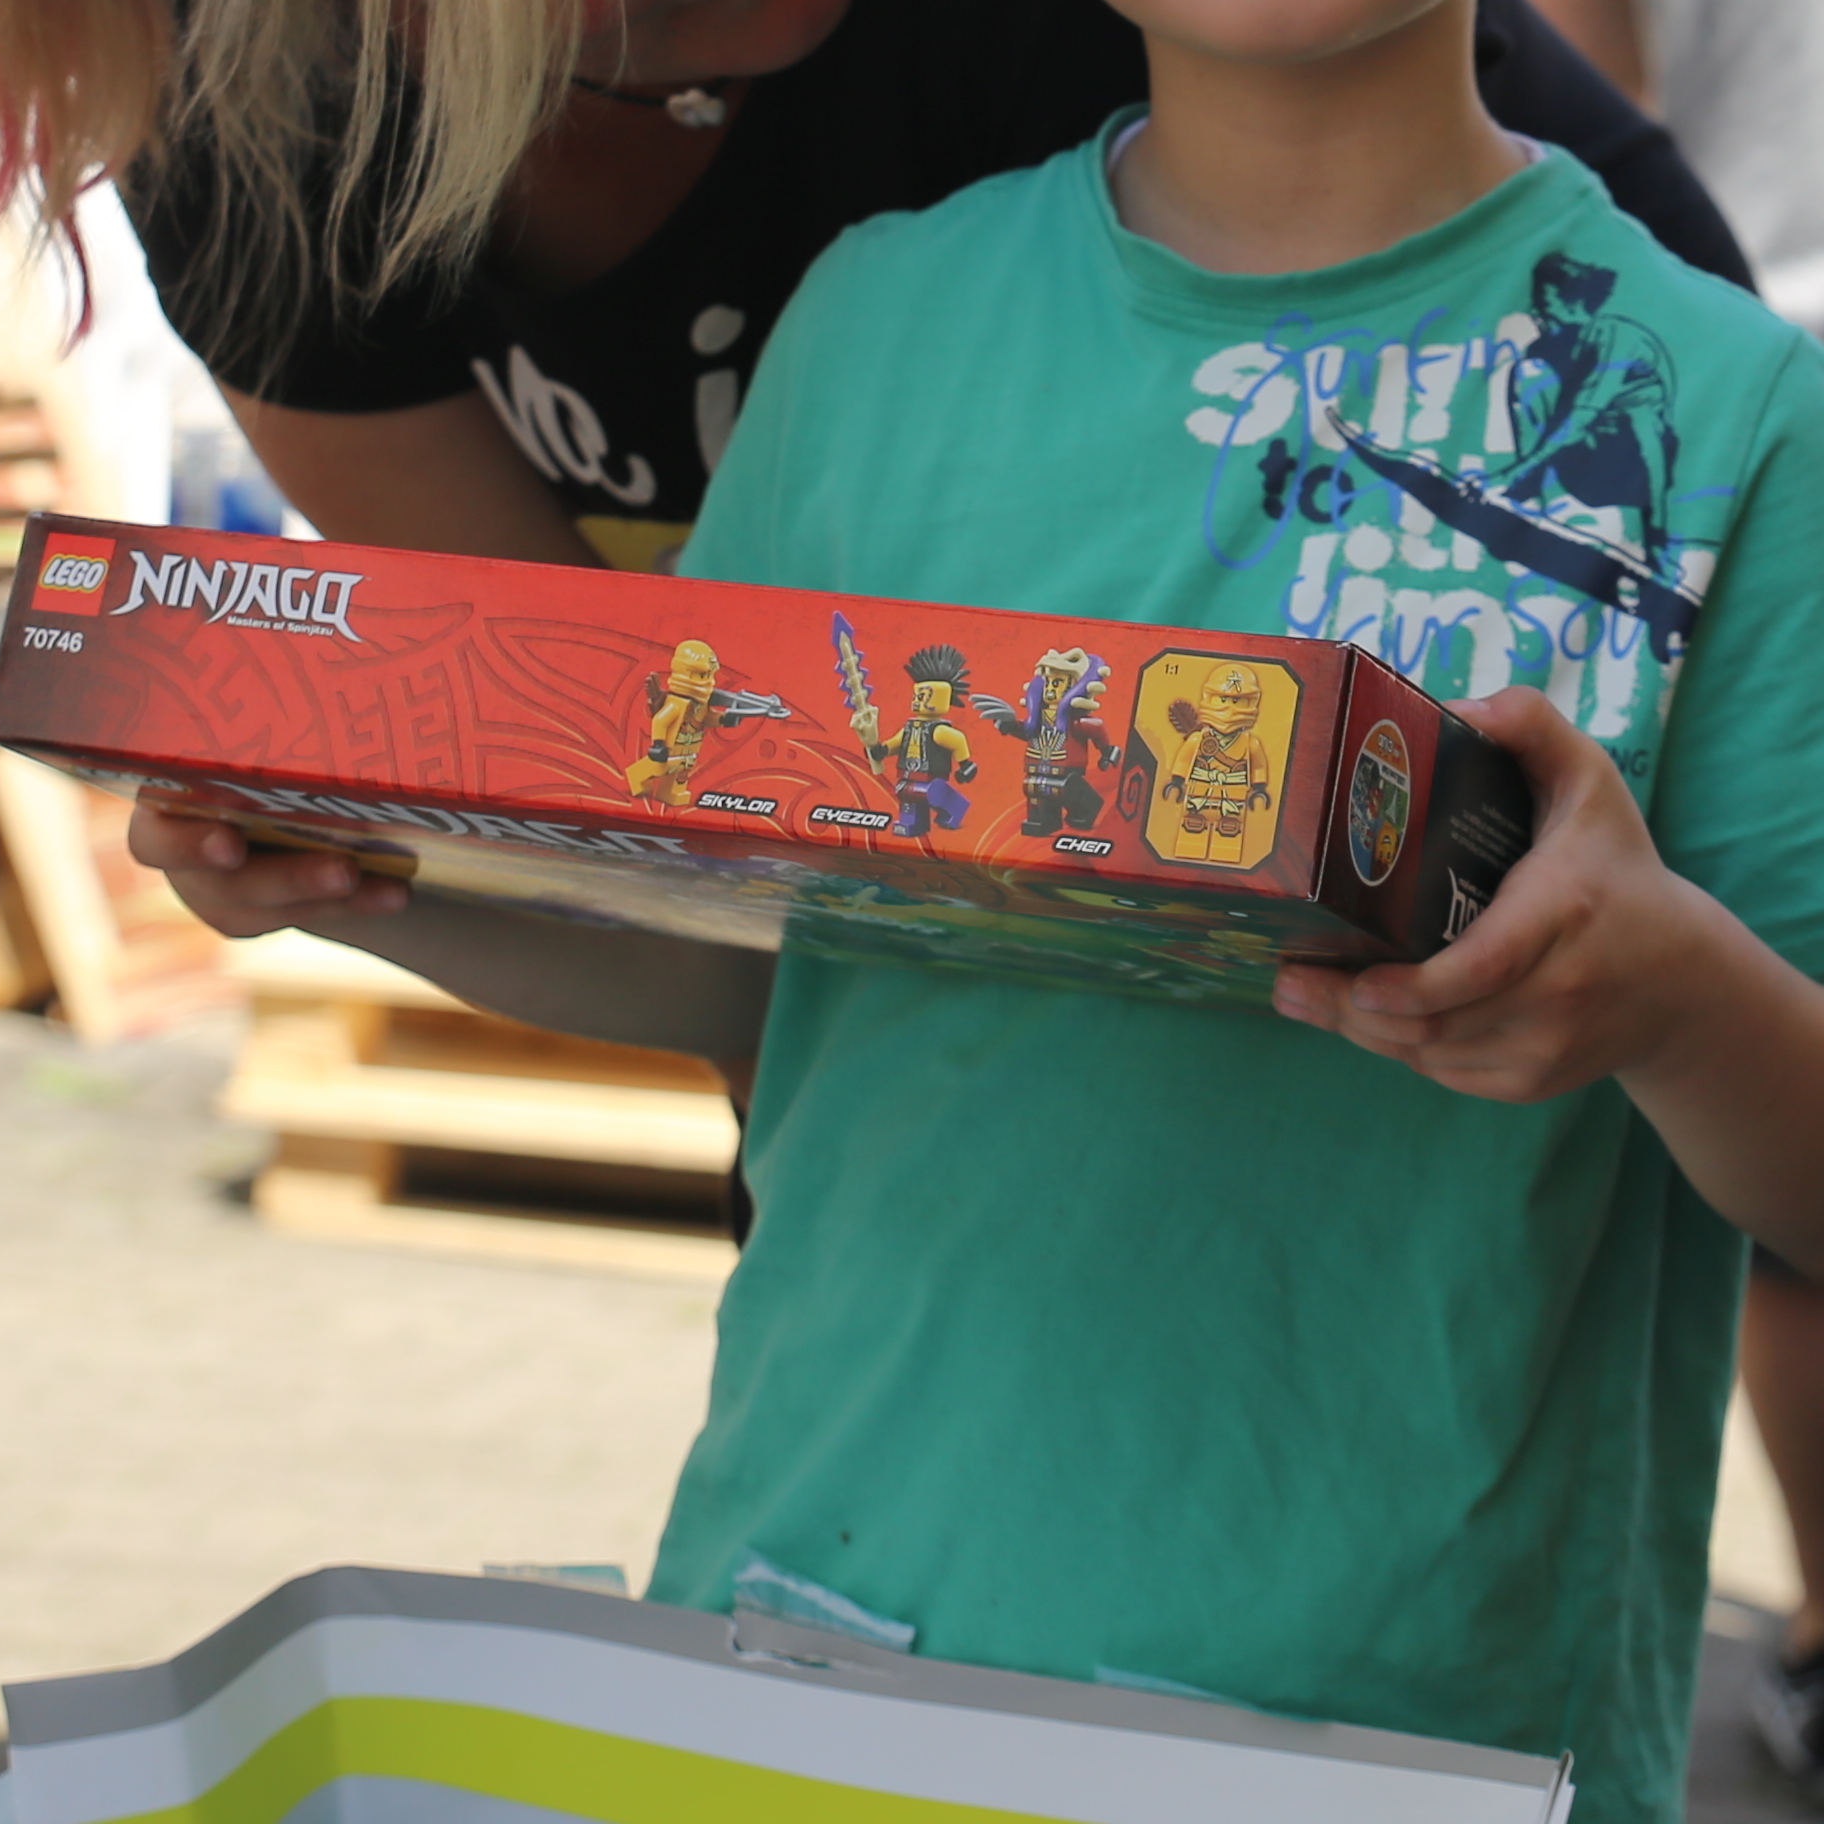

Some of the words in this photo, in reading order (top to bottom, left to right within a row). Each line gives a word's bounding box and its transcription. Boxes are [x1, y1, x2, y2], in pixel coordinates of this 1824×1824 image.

[1258, 438, 1354, 525] to
[42, 556, 107, 592] LEGO
[109, 551, 364, 643] NINJAGO
[226, 615, 271, 629] Masters
[273, 621, 286, 630] of
[287, 622, 334, 637] Spinjitzu
[23, 626, 83, 653] 70746
[1164, 663, 1180, 675] 1:1
[698, 793, 776, 813] SKYLOR
[811, 807, 890, 828] EYEZOR
[1054, 837, 1112, 855] CHEN
